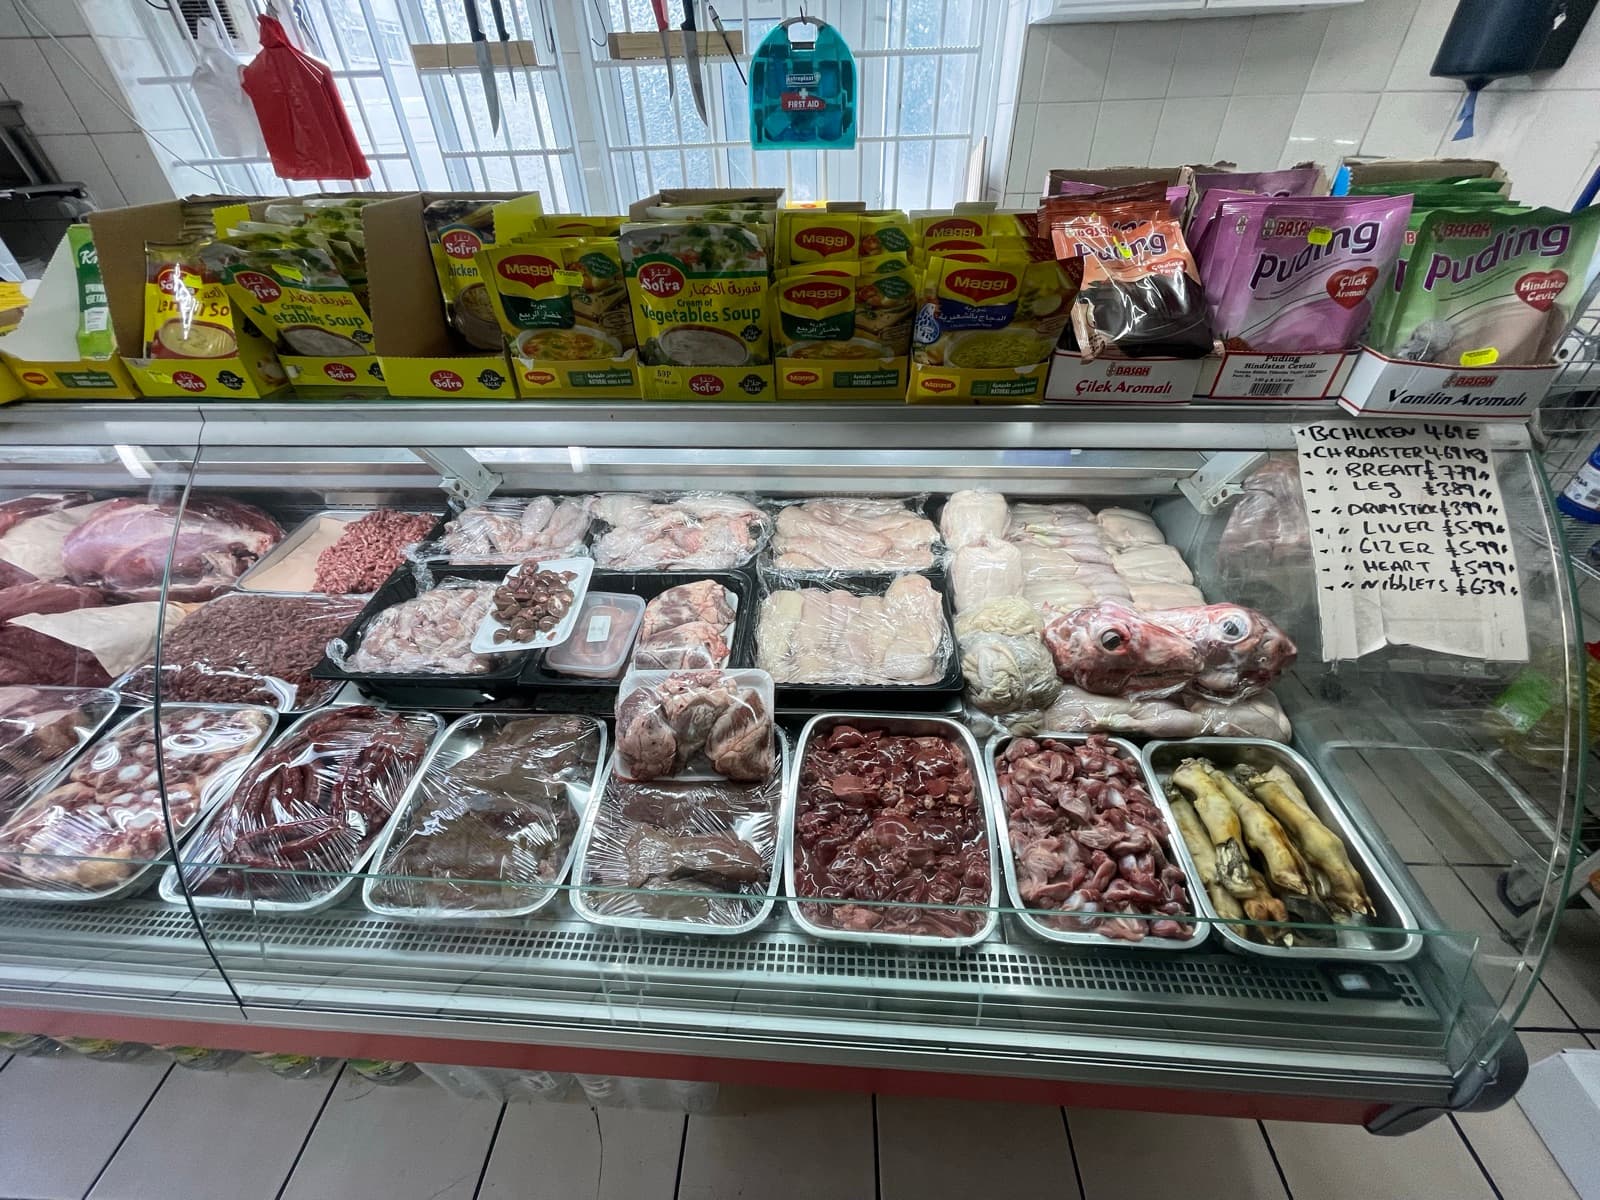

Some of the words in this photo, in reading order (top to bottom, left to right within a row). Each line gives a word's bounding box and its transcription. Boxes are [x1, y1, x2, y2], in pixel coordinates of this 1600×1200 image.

[787, 100, 806, 108] FIRST
[808, 100, 820, 108] AID
[932, 227, 976, 237] Maggi
[802, 234, 848, 247] Maggi
[446, 242, 478, 255] Sofra
[1423, 224, 1572, 292] puding
[505, 263, 553, 276] Maggi
[642, 278, 680, 292] Sofra
[954, 276, 1009, 291] Maggi
[1339, 274, 1368, 288] Çilek
[792, 288, 842, 299] Maggi
[1526, 290, 1557, 302] Ceviz
[677, 299, 701, 307] Cream
[640, 304, 719, 325] Vegetables
[723, 307, 761, 323] Soup
[325, 314, 365, 329] Soup
[1265, 355, 1301, 363] Puding
[328, 370, 356, 379] Sofra
[433, 378, 462, 388] Sofra
[692, 382, 721, 393] Sofra
[1076, 380, 1112, 396] Çilek
[1114, 381, 1173, 394] Aromalı
[1389, 389, 1453, 405] Vanilin
[1452, 392, 1528, 406] Aromalı
[1344, 446, 1424, 459] ROASTER
[1345, 462, 1424, 477] BREAST
[1363, 521, 1435, 535] LIVER
[1363, 559, 1430, 574] HEART
